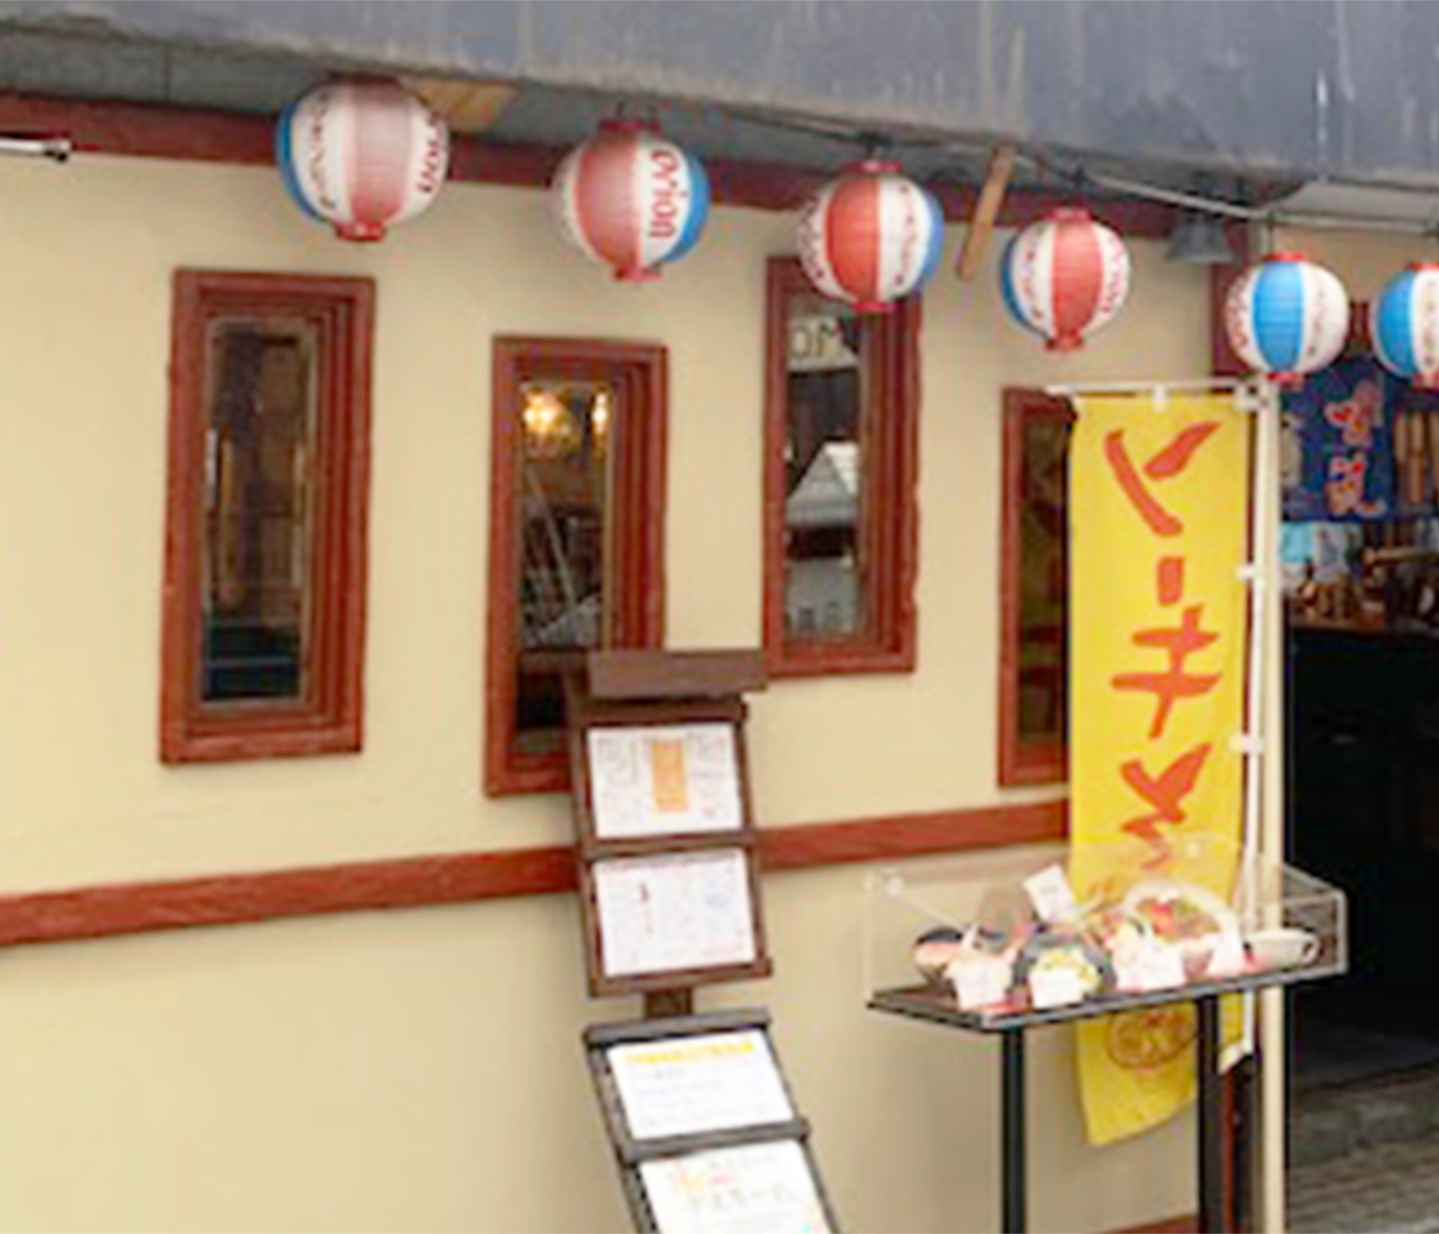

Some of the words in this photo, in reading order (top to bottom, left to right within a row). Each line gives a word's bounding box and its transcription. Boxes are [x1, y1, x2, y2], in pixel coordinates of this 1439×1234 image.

[649, 149, 689, 239] Orion
[1103, 420, 1224, 895] ソーキそ
